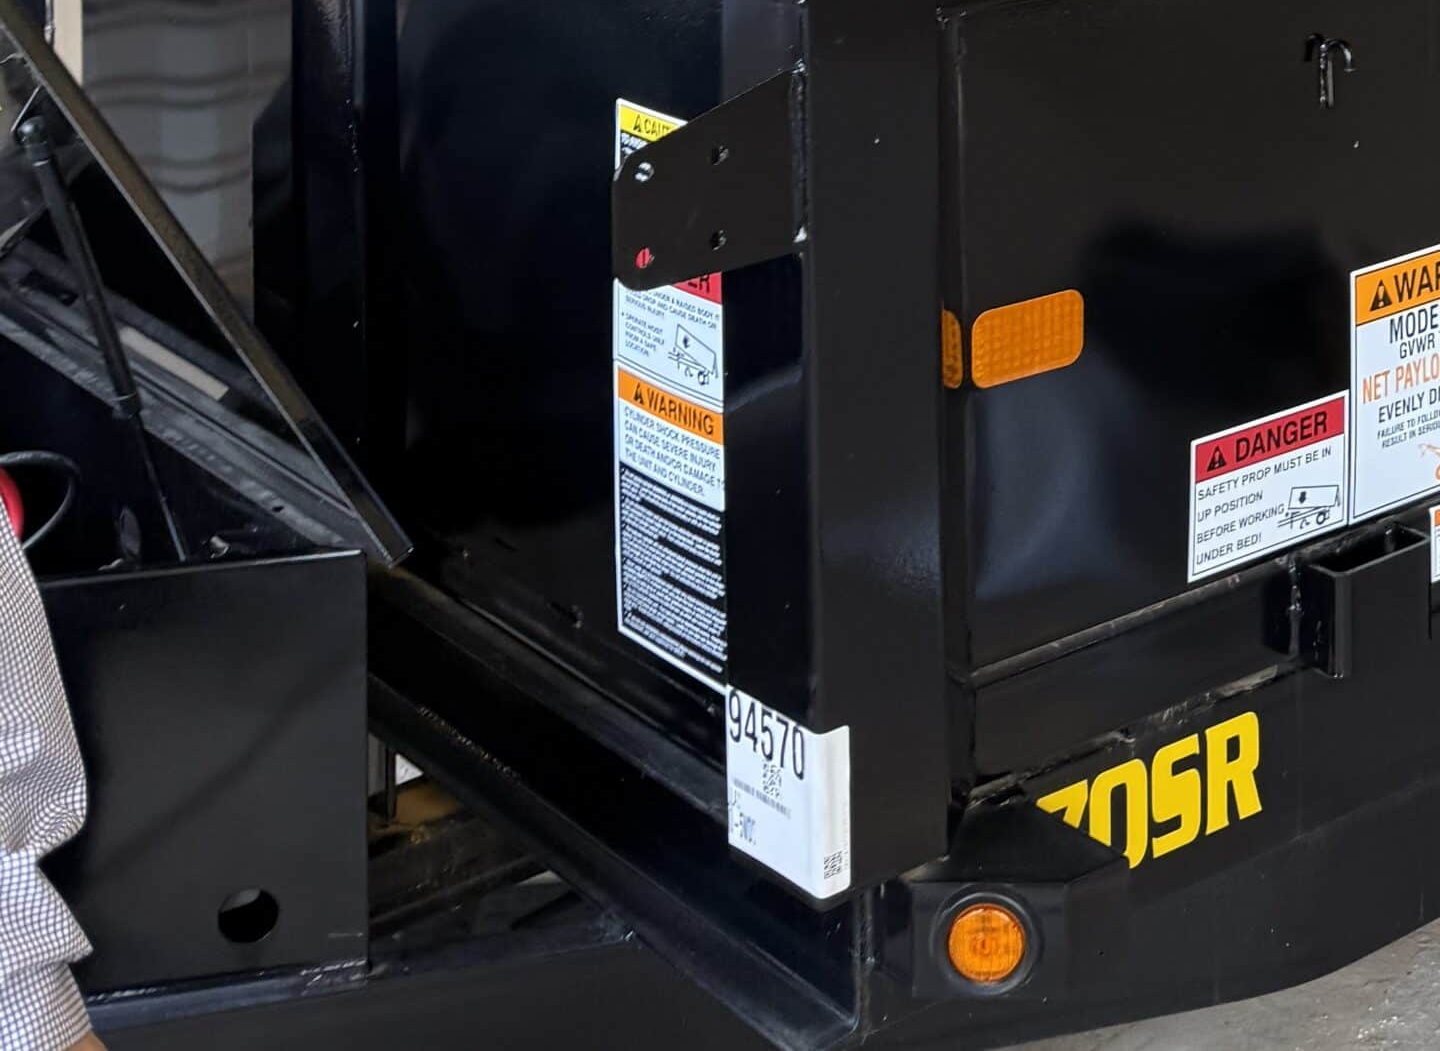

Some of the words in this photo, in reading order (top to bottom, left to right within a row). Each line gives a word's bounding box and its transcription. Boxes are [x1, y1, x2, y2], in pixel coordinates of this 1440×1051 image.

[644, 118, 670, 137] CAUT
[1399, 332, 1435, 359] GVWR
[1362, 370, 1391, 405] NET
[646, 388, 715, 436] WARNING
[1378, 391, 1425, 424] EVENLY
[624, 406, 655, 429] CYLINDER
[656, 422, 680, 442] SHOCK
[681, 434, 720, 460] PRESSURE
[624, 420, 638, 435] CAN
[639, 427, 660, 447] CAUSE
[661, 438, 689, 460] SEVERE
[1235, 410, 1328, 463] DANGER
[1377, 422, 1405, 440] FAILURE
[1407, 419, 1416, 430] TO
[1409, 428, 1417, 438] IN
[624, 433, 634, 445] OR
[634, 438, 656, 456] DEATH
[683, 463, 716, 488] DAMAGE
[624, 447, 638, 462] THE
[653, 463, 668, 479] AND
[1197, 477, 1239, 501] SAFETY
[1241, 466, 1271, 486] PROP
[1274, 455, 1303, 473] MUST
[1305, 450, 1318, 464] BE
[1322, 446, 1332, 459] IN
[1196, 521, 1237, 545] BEFORE
[1238, 503, 1285, 528] WORKING
[1197, 507, 1212, 523] UP
[1214, 490, 1263, 516] POSITION
[1196, 542, 1234, 565] UNDER
[1236, 532, 1262, 549] BED!
[728, 687, 806, 781] 94570
